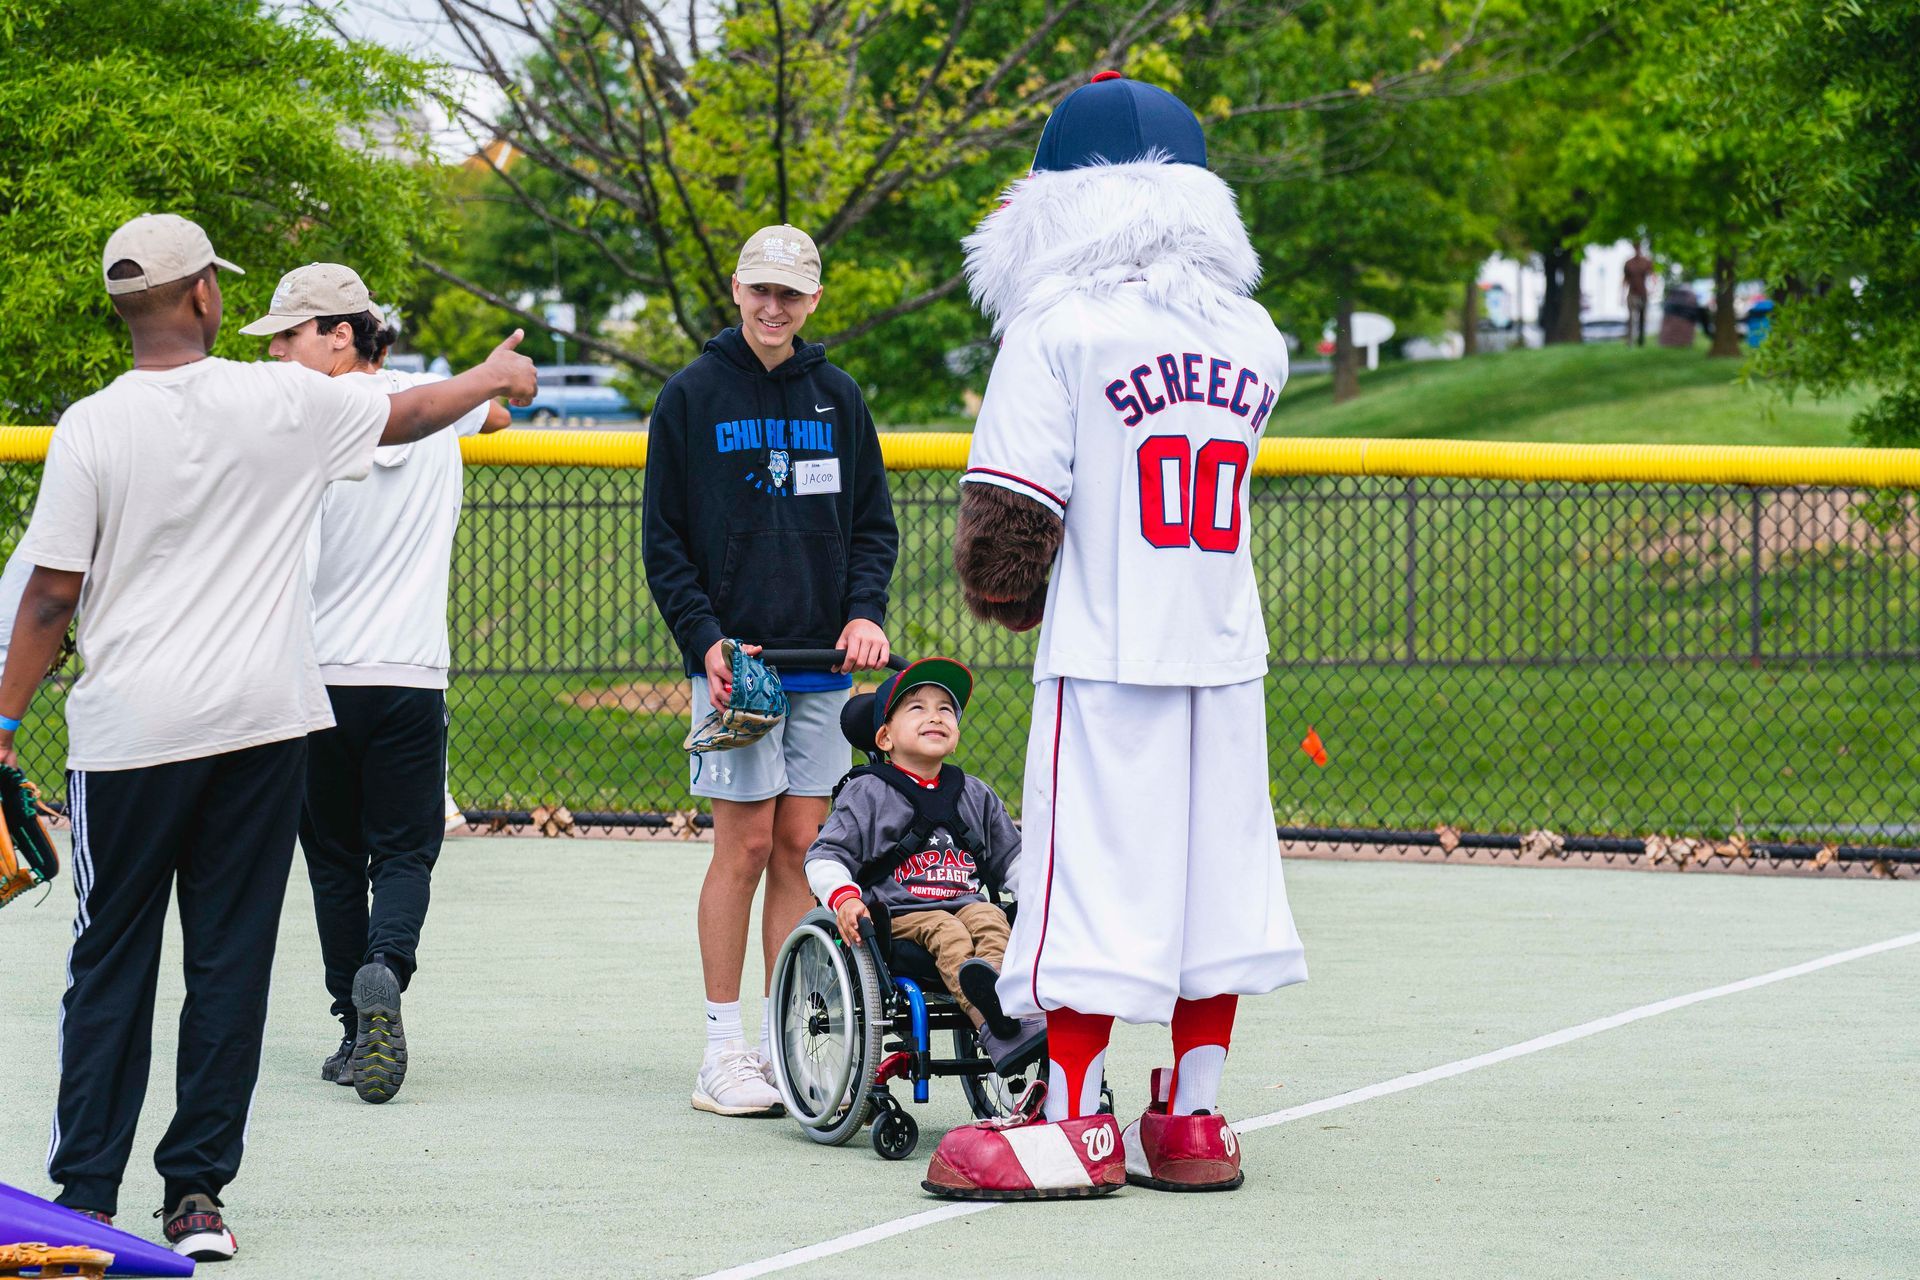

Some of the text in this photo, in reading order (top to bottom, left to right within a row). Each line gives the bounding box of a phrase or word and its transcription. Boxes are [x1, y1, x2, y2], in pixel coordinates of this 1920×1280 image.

[1105, 353, 1275, 433] SCREECH
[715, 419, 833, 452] CHURCHILL
[802, 473, 834, 486] JACOB
[1137, 434, 1249, 554] 00
[926, 868, 970, 884] LEAGU
